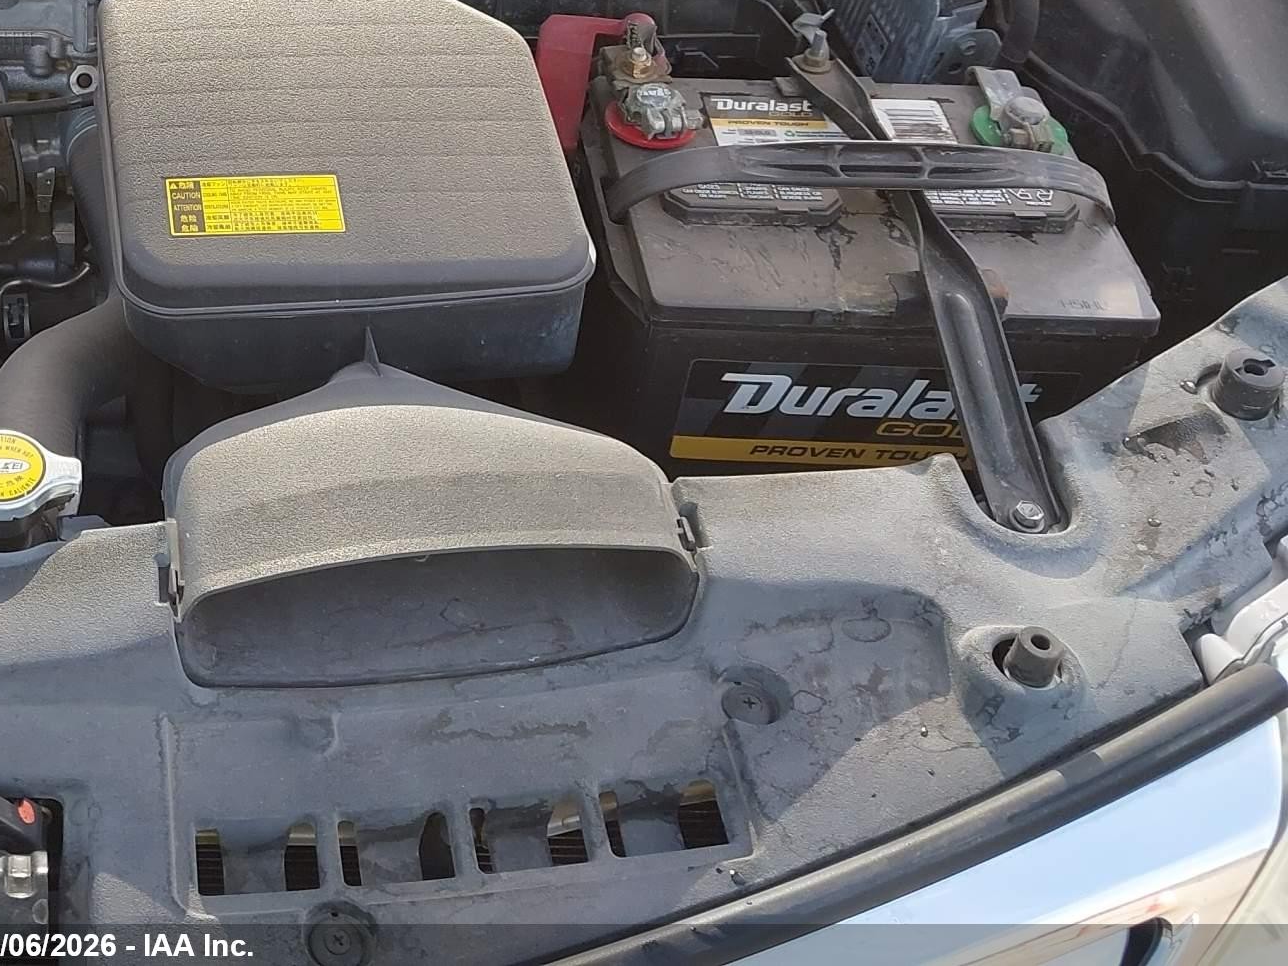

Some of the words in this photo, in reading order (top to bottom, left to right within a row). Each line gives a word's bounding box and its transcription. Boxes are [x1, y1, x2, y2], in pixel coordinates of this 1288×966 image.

[710, 98, 813, 112] Duralast
[171, 192, 201, 200] CAUTION
[174, 203, 203, 212] ATTENTION
[721, 372, 1040, 421] Durala
[5, 445, 22, 453] WHEN
[749, 444, 866, 459] PROVEN
